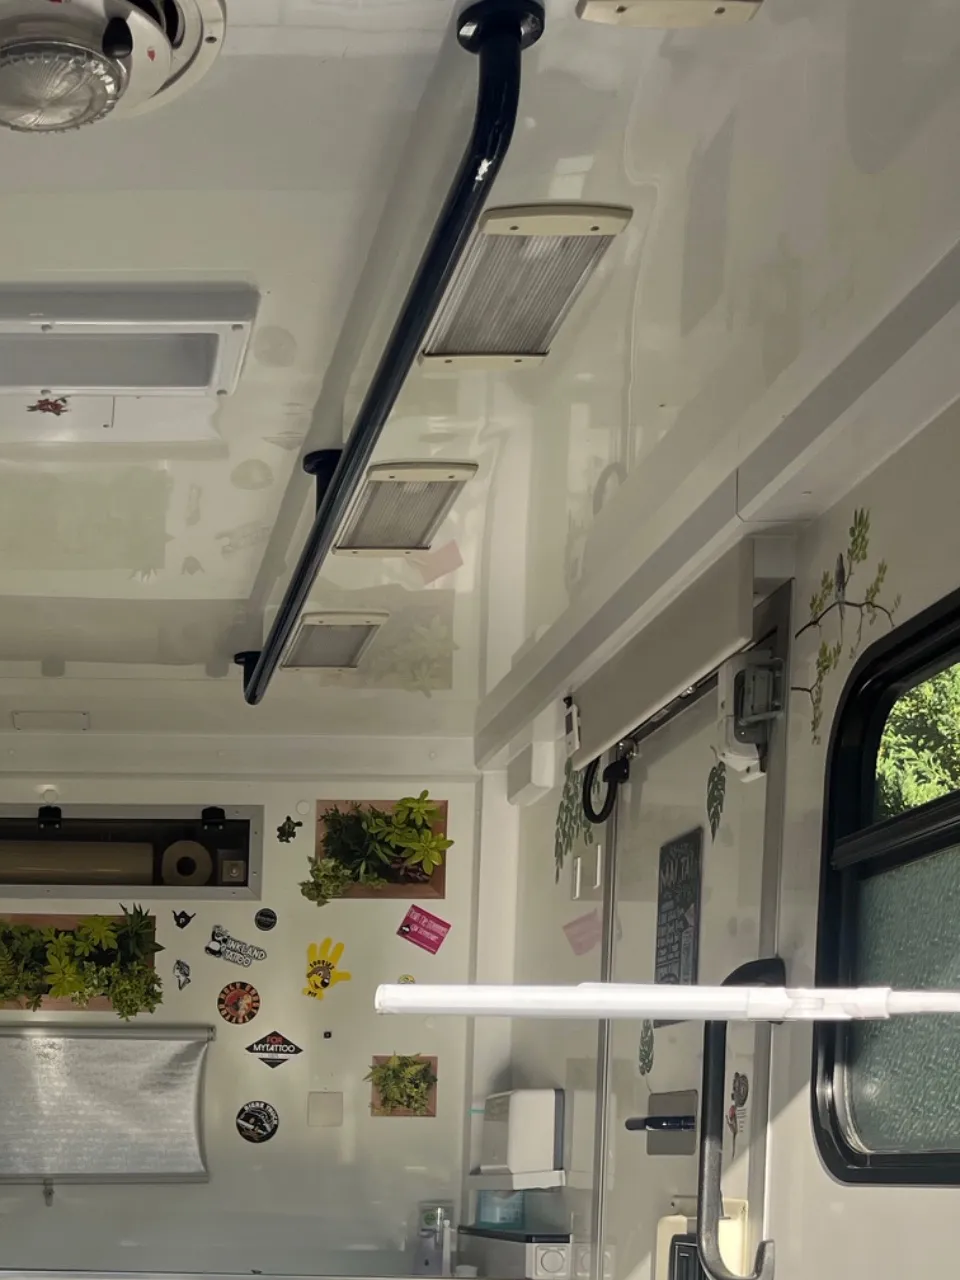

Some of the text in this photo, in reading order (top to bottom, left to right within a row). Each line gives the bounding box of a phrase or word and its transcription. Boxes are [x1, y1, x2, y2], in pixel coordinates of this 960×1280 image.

[228, 939, 266, 960] INKLAND
[266, 1035, 284, 1044] FOR
[253, 1043, 296, 1053] MYTATTOO
